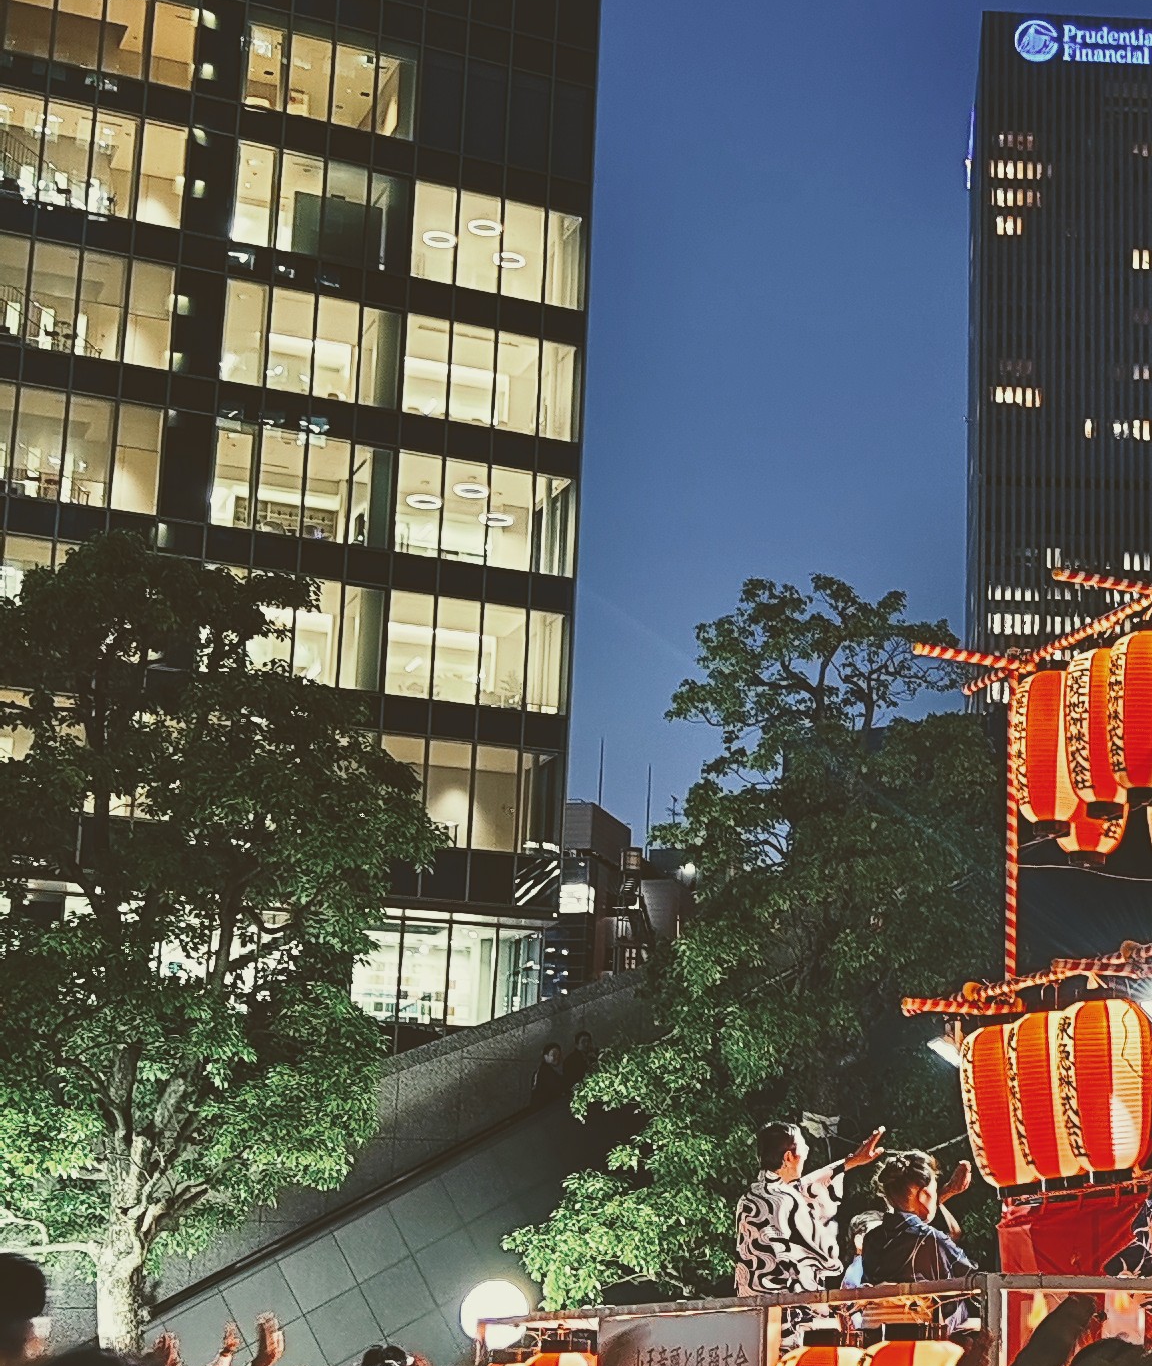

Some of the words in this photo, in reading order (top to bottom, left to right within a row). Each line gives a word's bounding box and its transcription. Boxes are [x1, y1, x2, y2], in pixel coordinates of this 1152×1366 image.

[1063, 43, 1150, 65] Financial
[1065, 657, 1095, 790] 三菱地所株式会社
